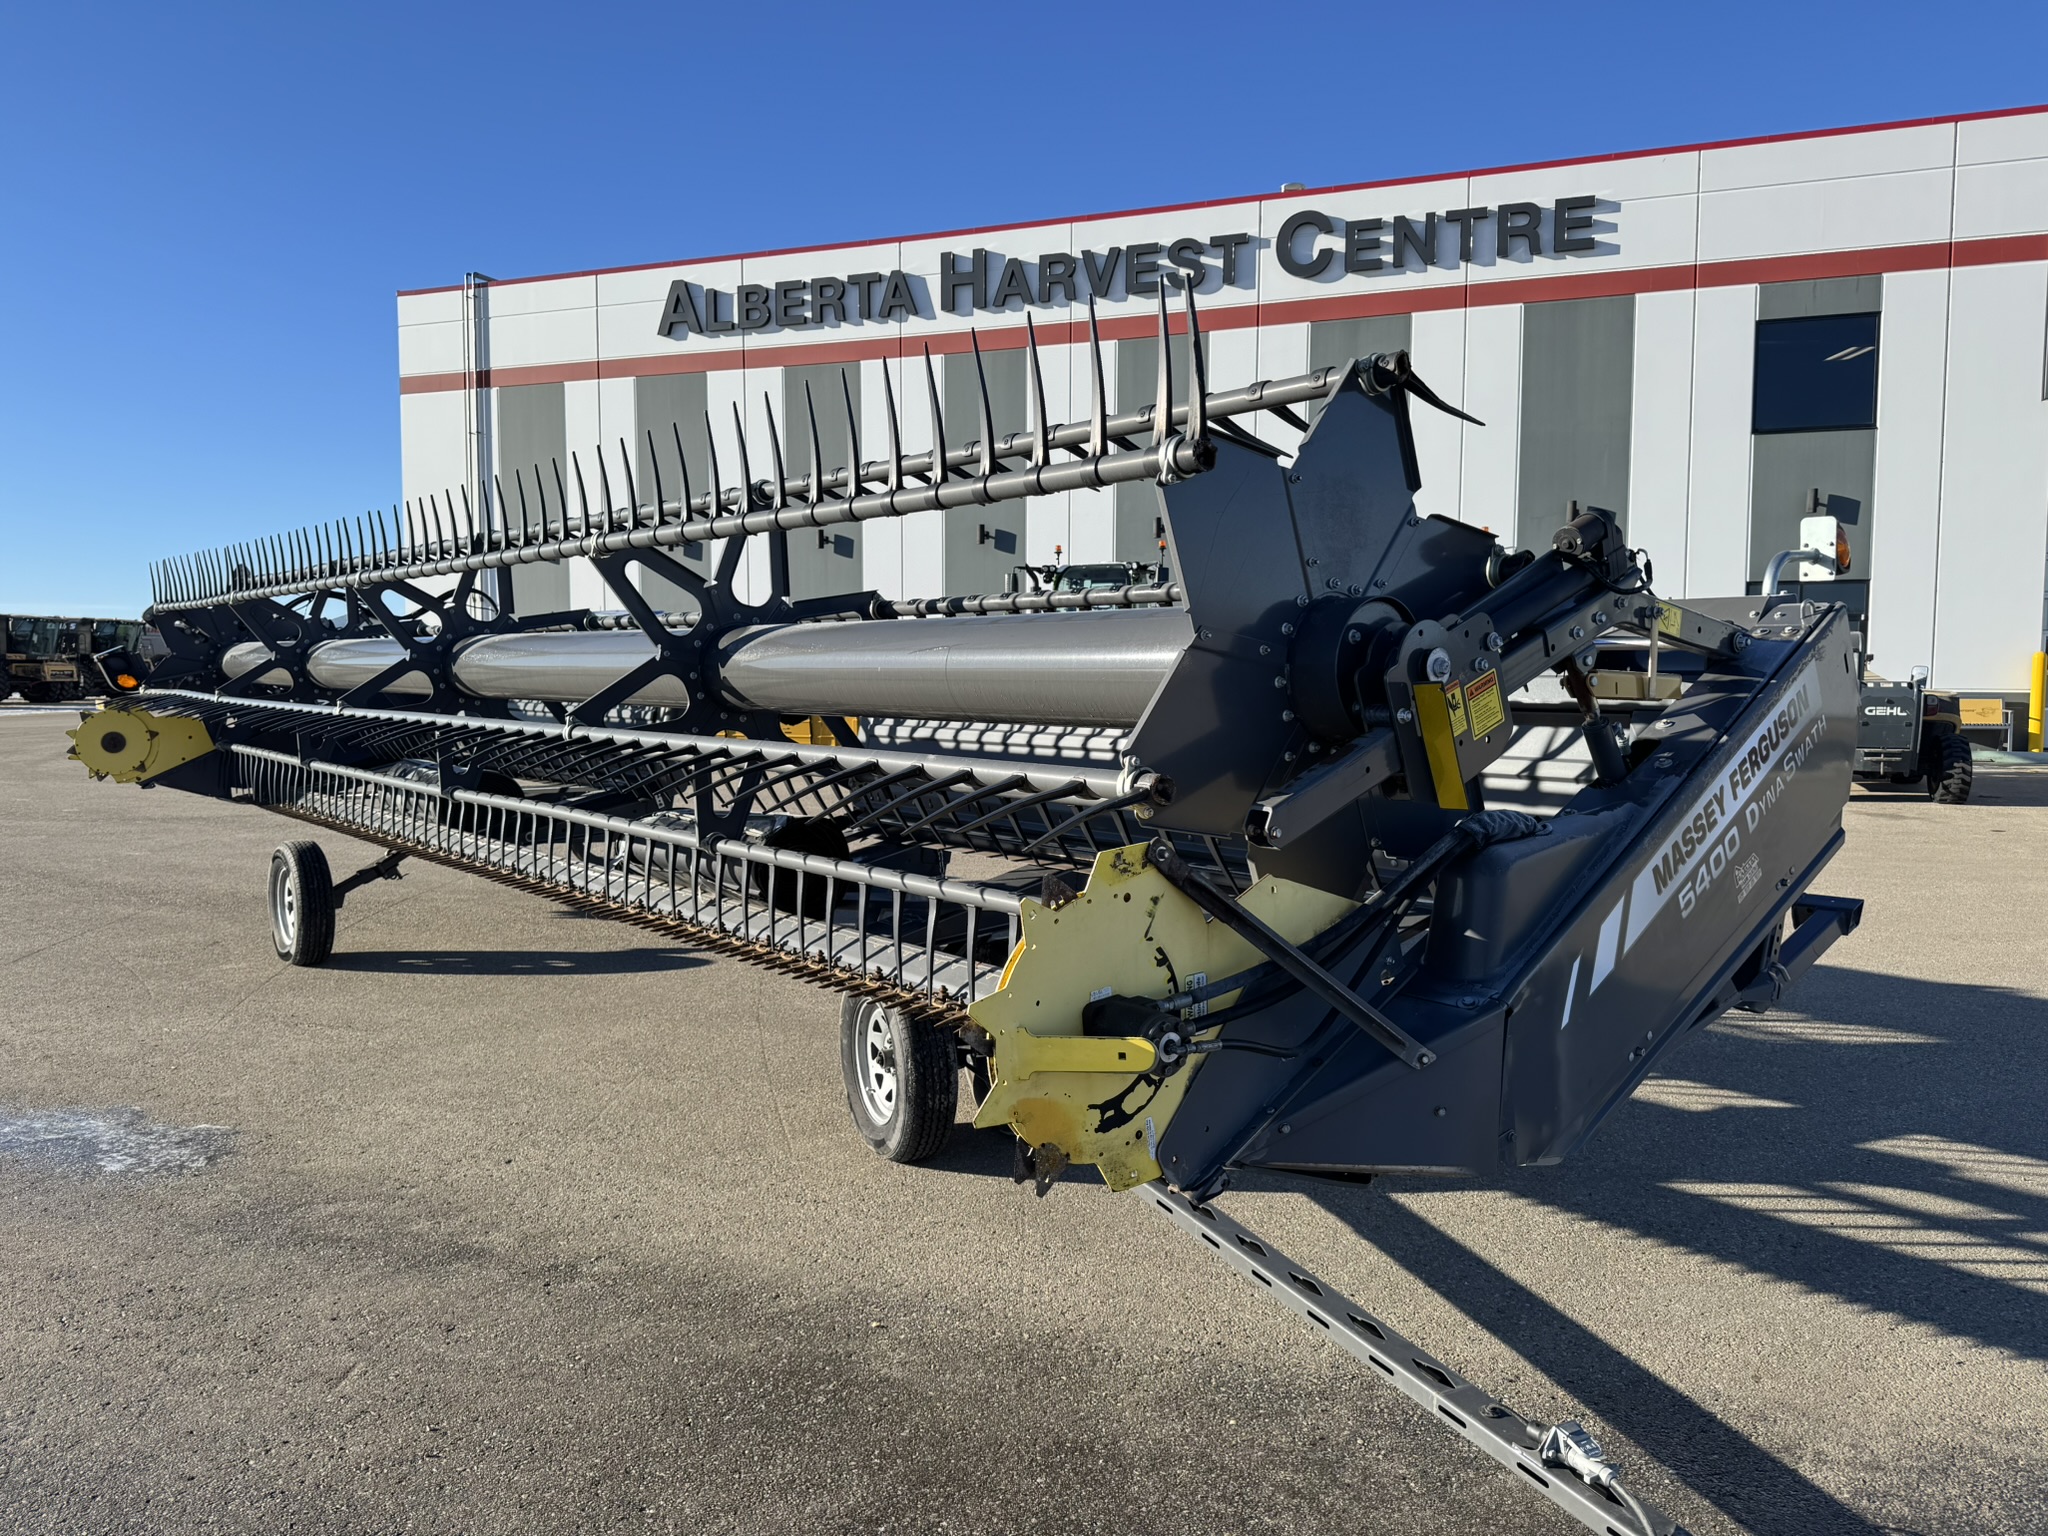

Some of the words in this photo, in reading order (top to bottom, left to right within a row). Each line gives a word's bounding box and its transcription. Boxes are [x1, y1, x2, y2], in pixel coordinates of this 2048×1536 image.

[657, 269, 918, 337] ALBERTA
[940, 232, 1249, 312] HARVEST
[1276, 195, 1597, 279] CENTRE
[1864, 706, 1907, 716] GEHL
[1651, 784, 1725, 896] MASSEY
[1728, 684, 1810, 801] FERGUSON
[1678, 825, 1741, 919] 5400
